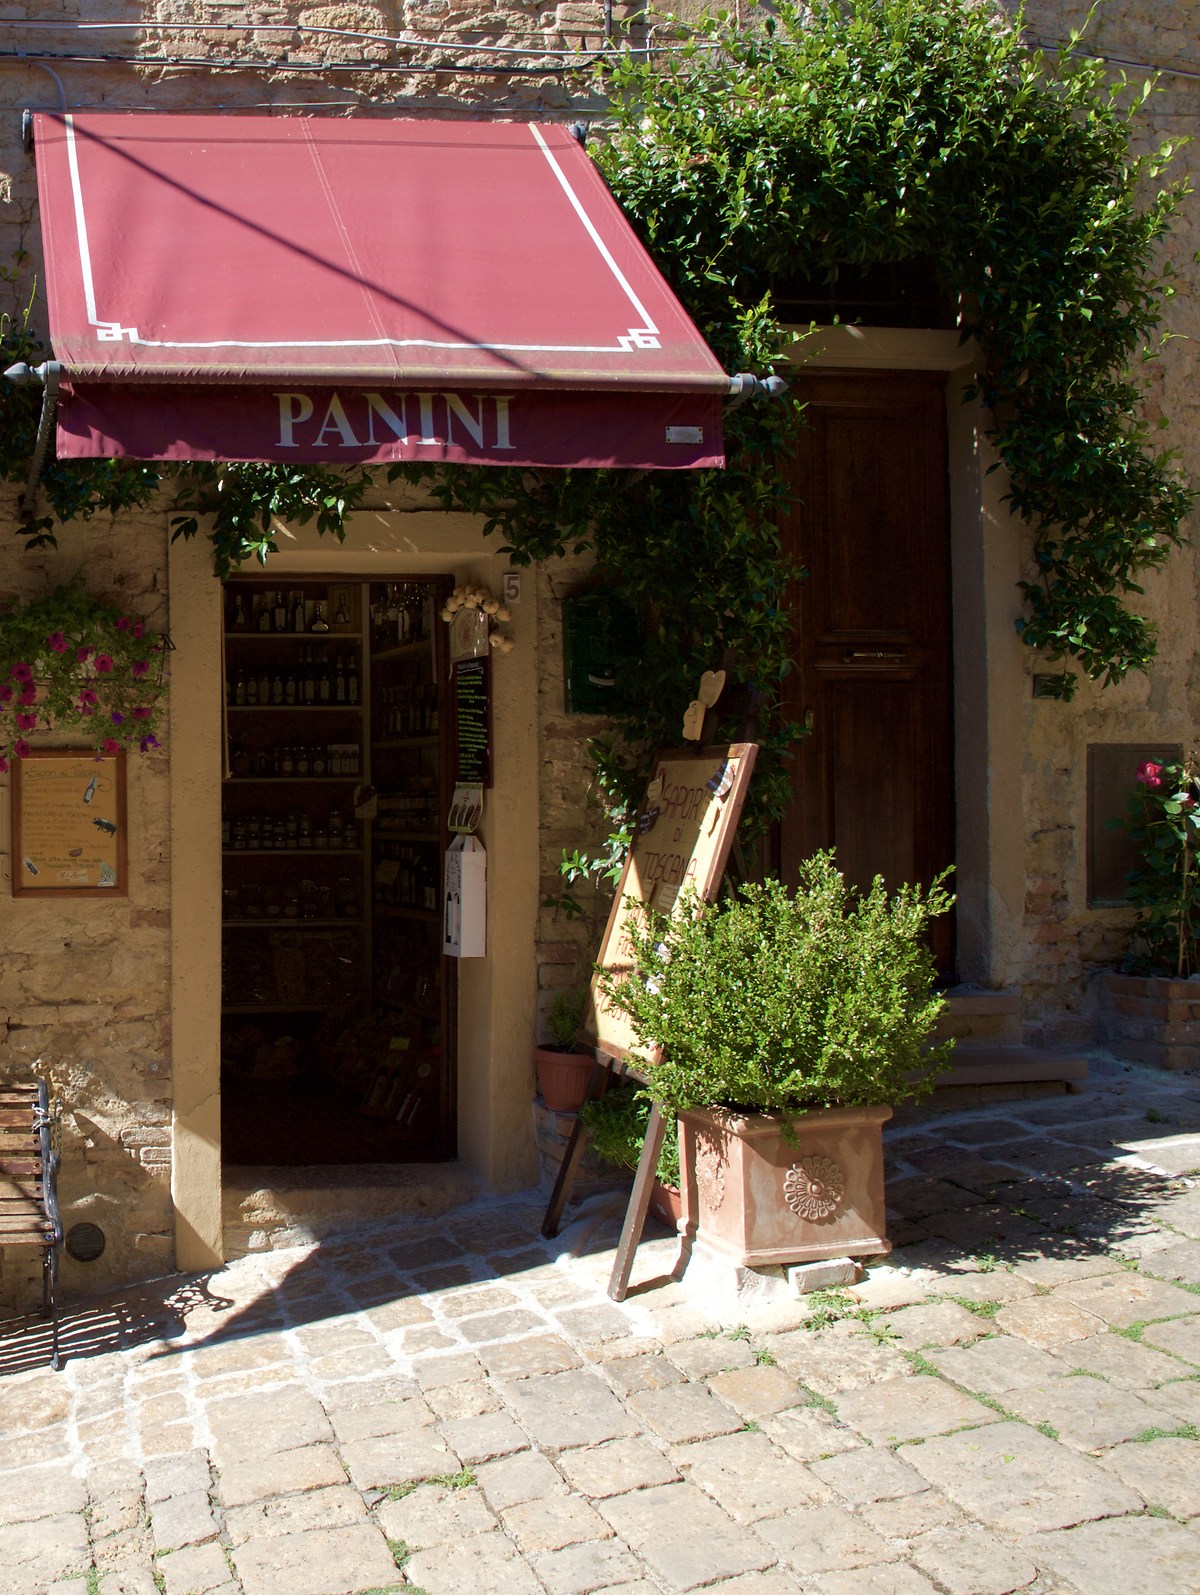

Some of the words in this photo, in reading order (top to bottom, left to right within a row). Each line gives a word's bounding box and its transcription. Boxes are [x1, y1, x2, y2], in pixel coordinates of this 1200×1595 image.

[272, 392, 516, 449] PANINI
[506, 576, 519, 600] 5
[642, 852, 698, 887] TOSCANA
